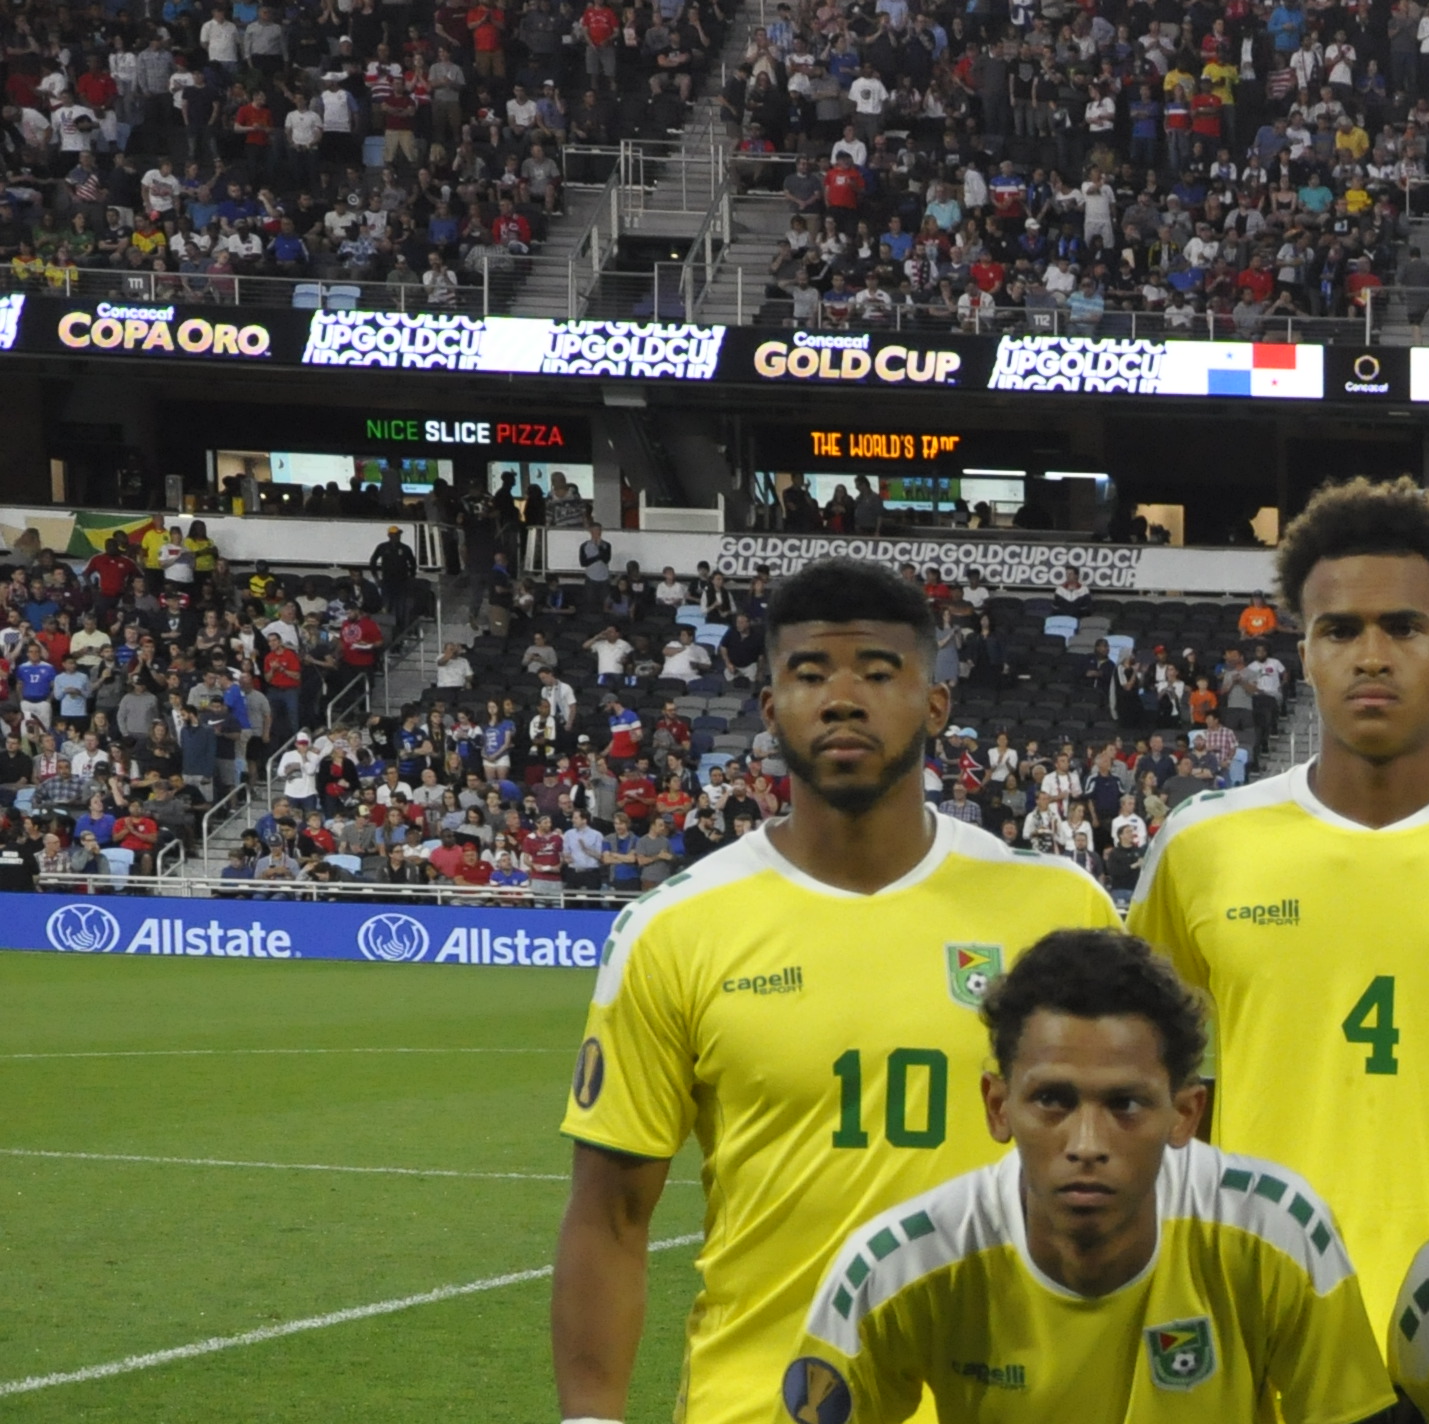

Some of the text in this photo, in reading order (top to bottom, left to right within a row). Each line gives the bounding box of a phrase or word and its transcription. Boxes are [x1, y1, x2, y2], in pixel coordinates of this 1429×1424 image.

[97, 303, 175, 321] Concacaf
[1033, 314, 1051, 327] 112
[58, 312, 174, 352] COPA
[177, 318, 270, 356] ORO
[793, 331, 870, 350] Concacaf
[753, 341, 872, 380] GOLD
[874, 345, 961, 383] CUP
[366, 418, 564, 446] NICE SLICE PIZZA
[811, 432, 842, 457] THE
[850, 434, 914, 459] WORLD'S
[1225, 899, 1300, 924] capelli
[128, 917, 598, 968] Allstate Allstate
[722, 965, 804, 995] capelli
[1341, 975, 1400, 1076] 4
[832, 1046, 949, 1150] 10
